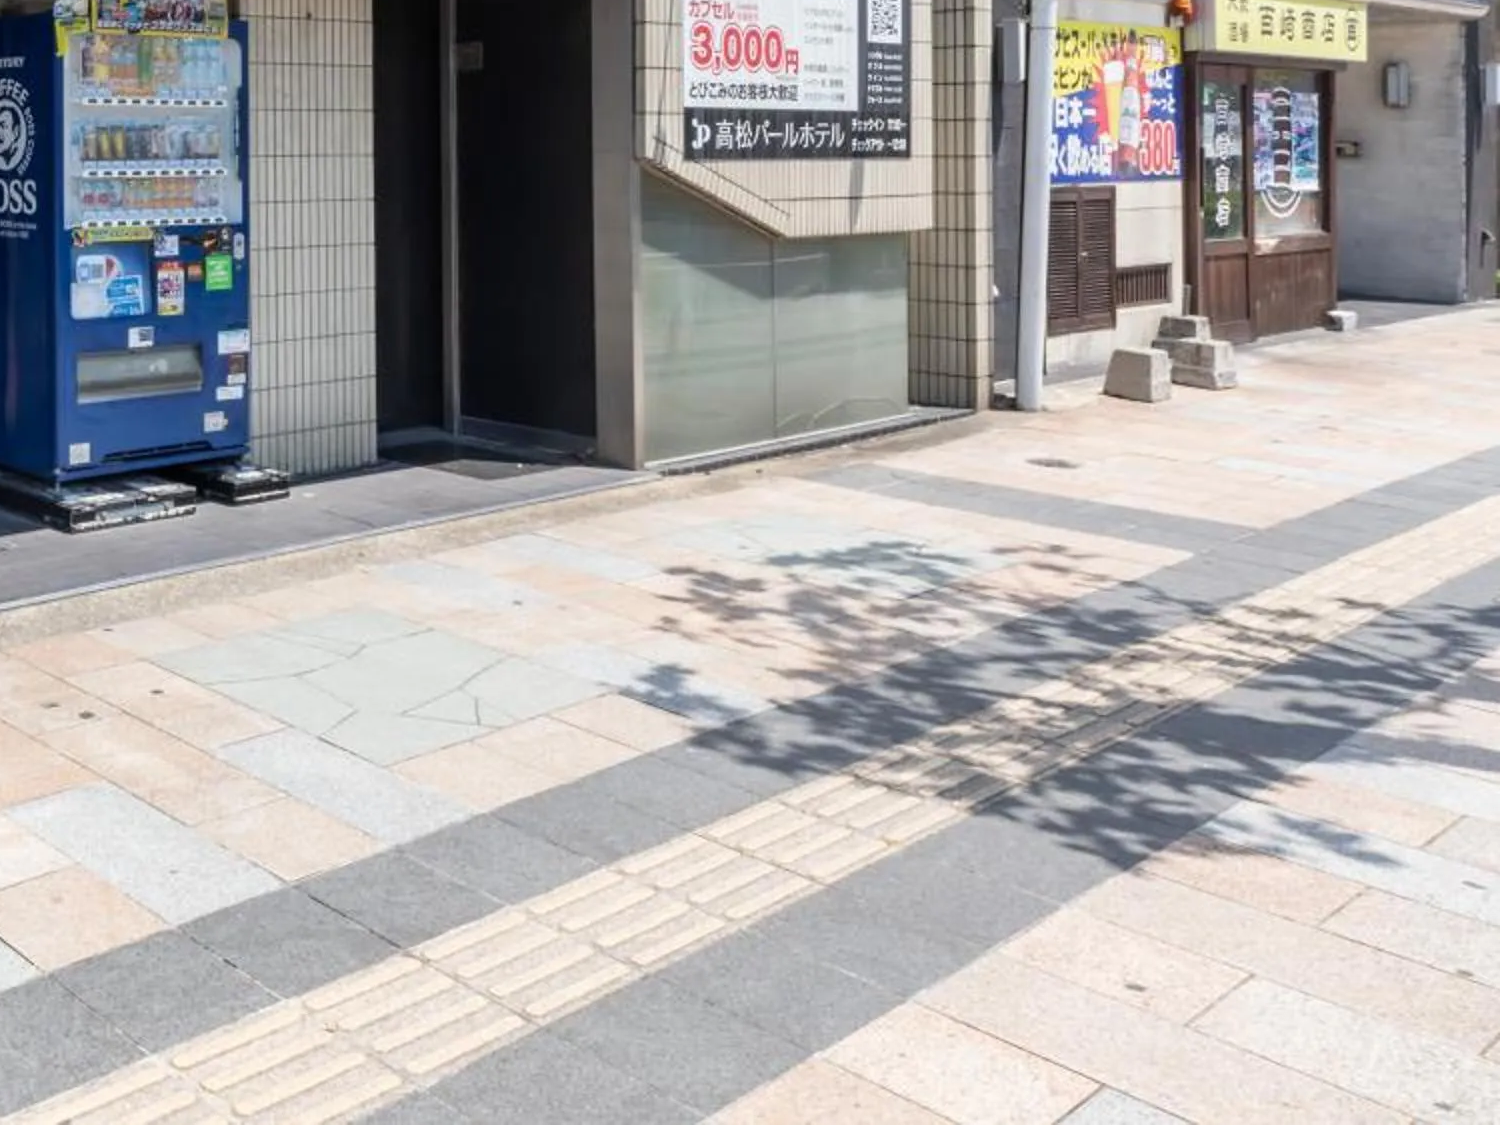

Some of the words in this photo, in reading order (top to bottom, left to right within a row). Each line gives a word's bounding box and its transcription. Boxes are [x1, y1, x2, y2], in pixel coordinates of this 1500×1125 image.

[691, 22, 800, 75] 3,000円
[715, 119, 846, 150] 高松パールホテル
